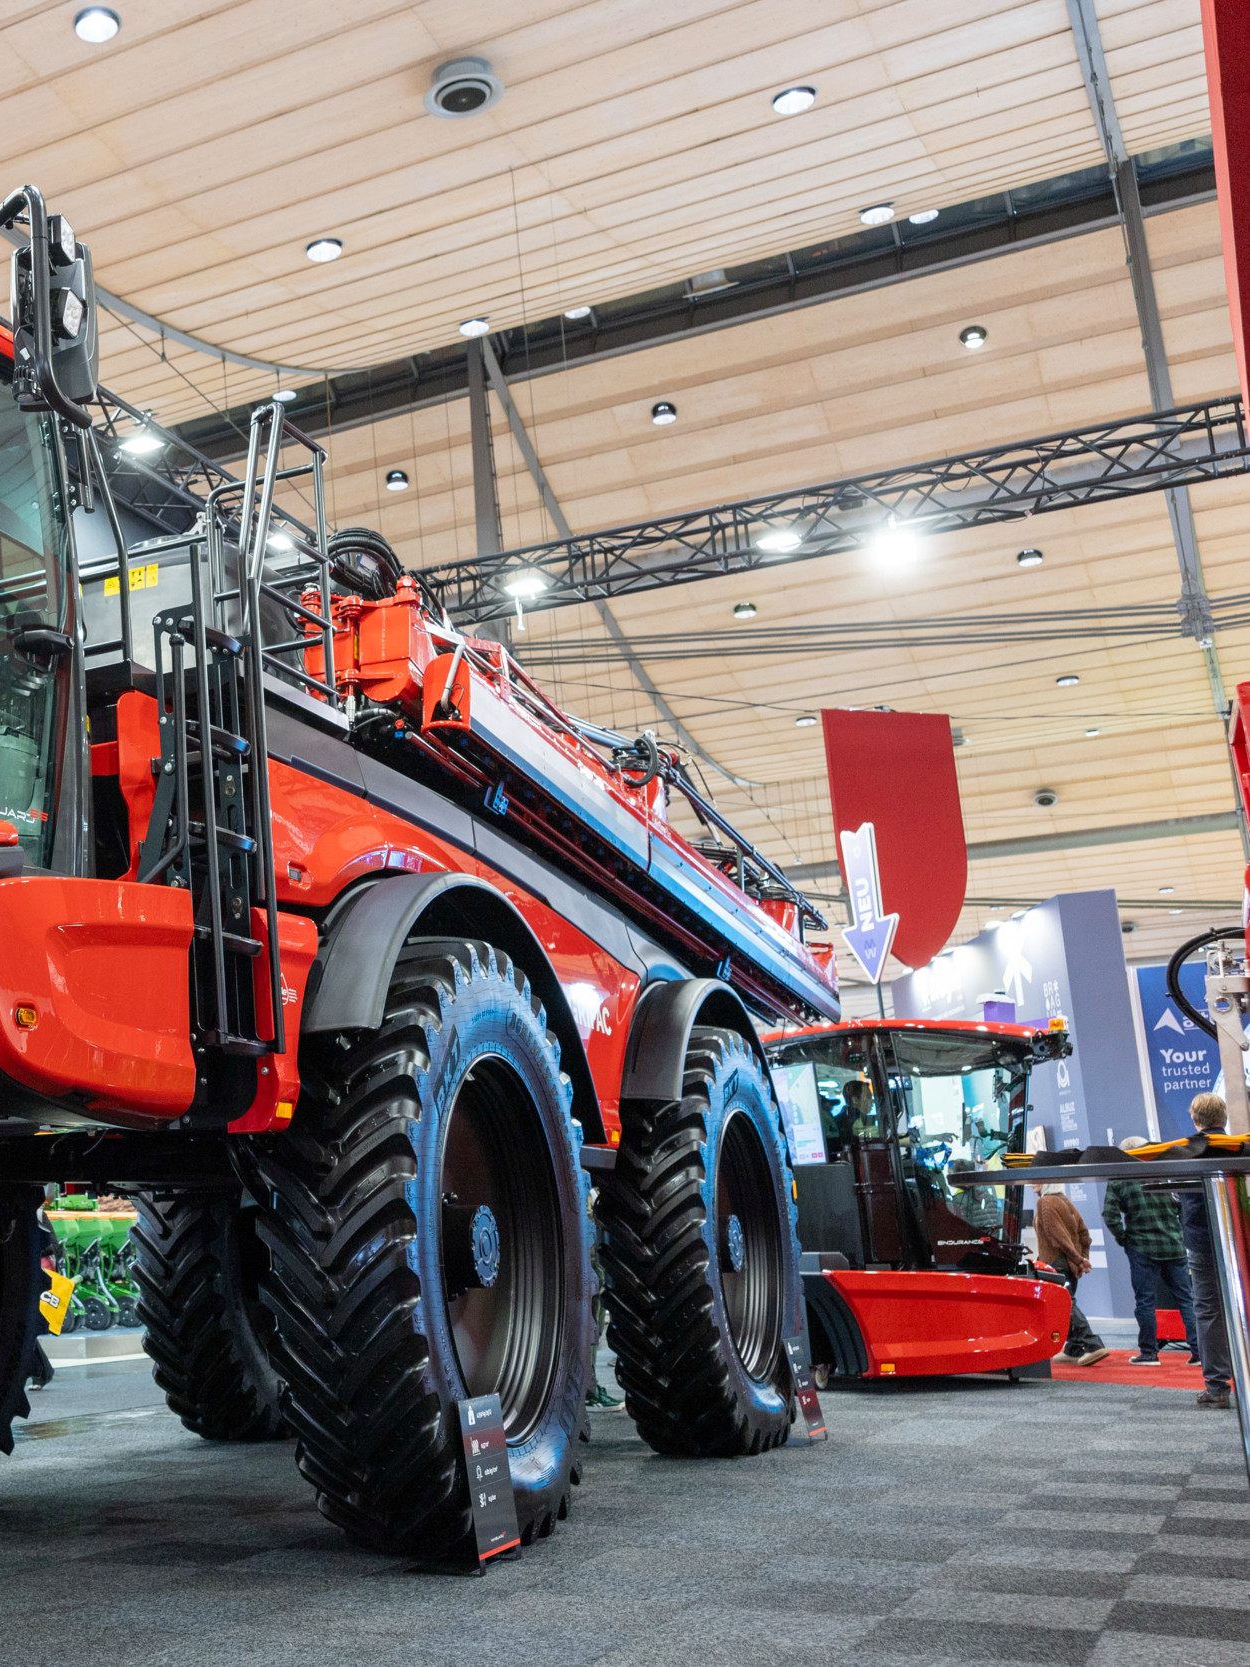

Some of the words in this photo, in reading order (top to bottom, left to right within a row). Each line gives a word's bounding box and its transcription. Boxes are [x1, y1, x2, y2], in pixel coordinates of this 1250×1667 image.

[856, 877, 875, 932] NEU
[1160, 1048, 1206, 1063] Your
[1162, 1062, 1210, 1077] trusted
[1164, 1078, 1211, 1093] partner
